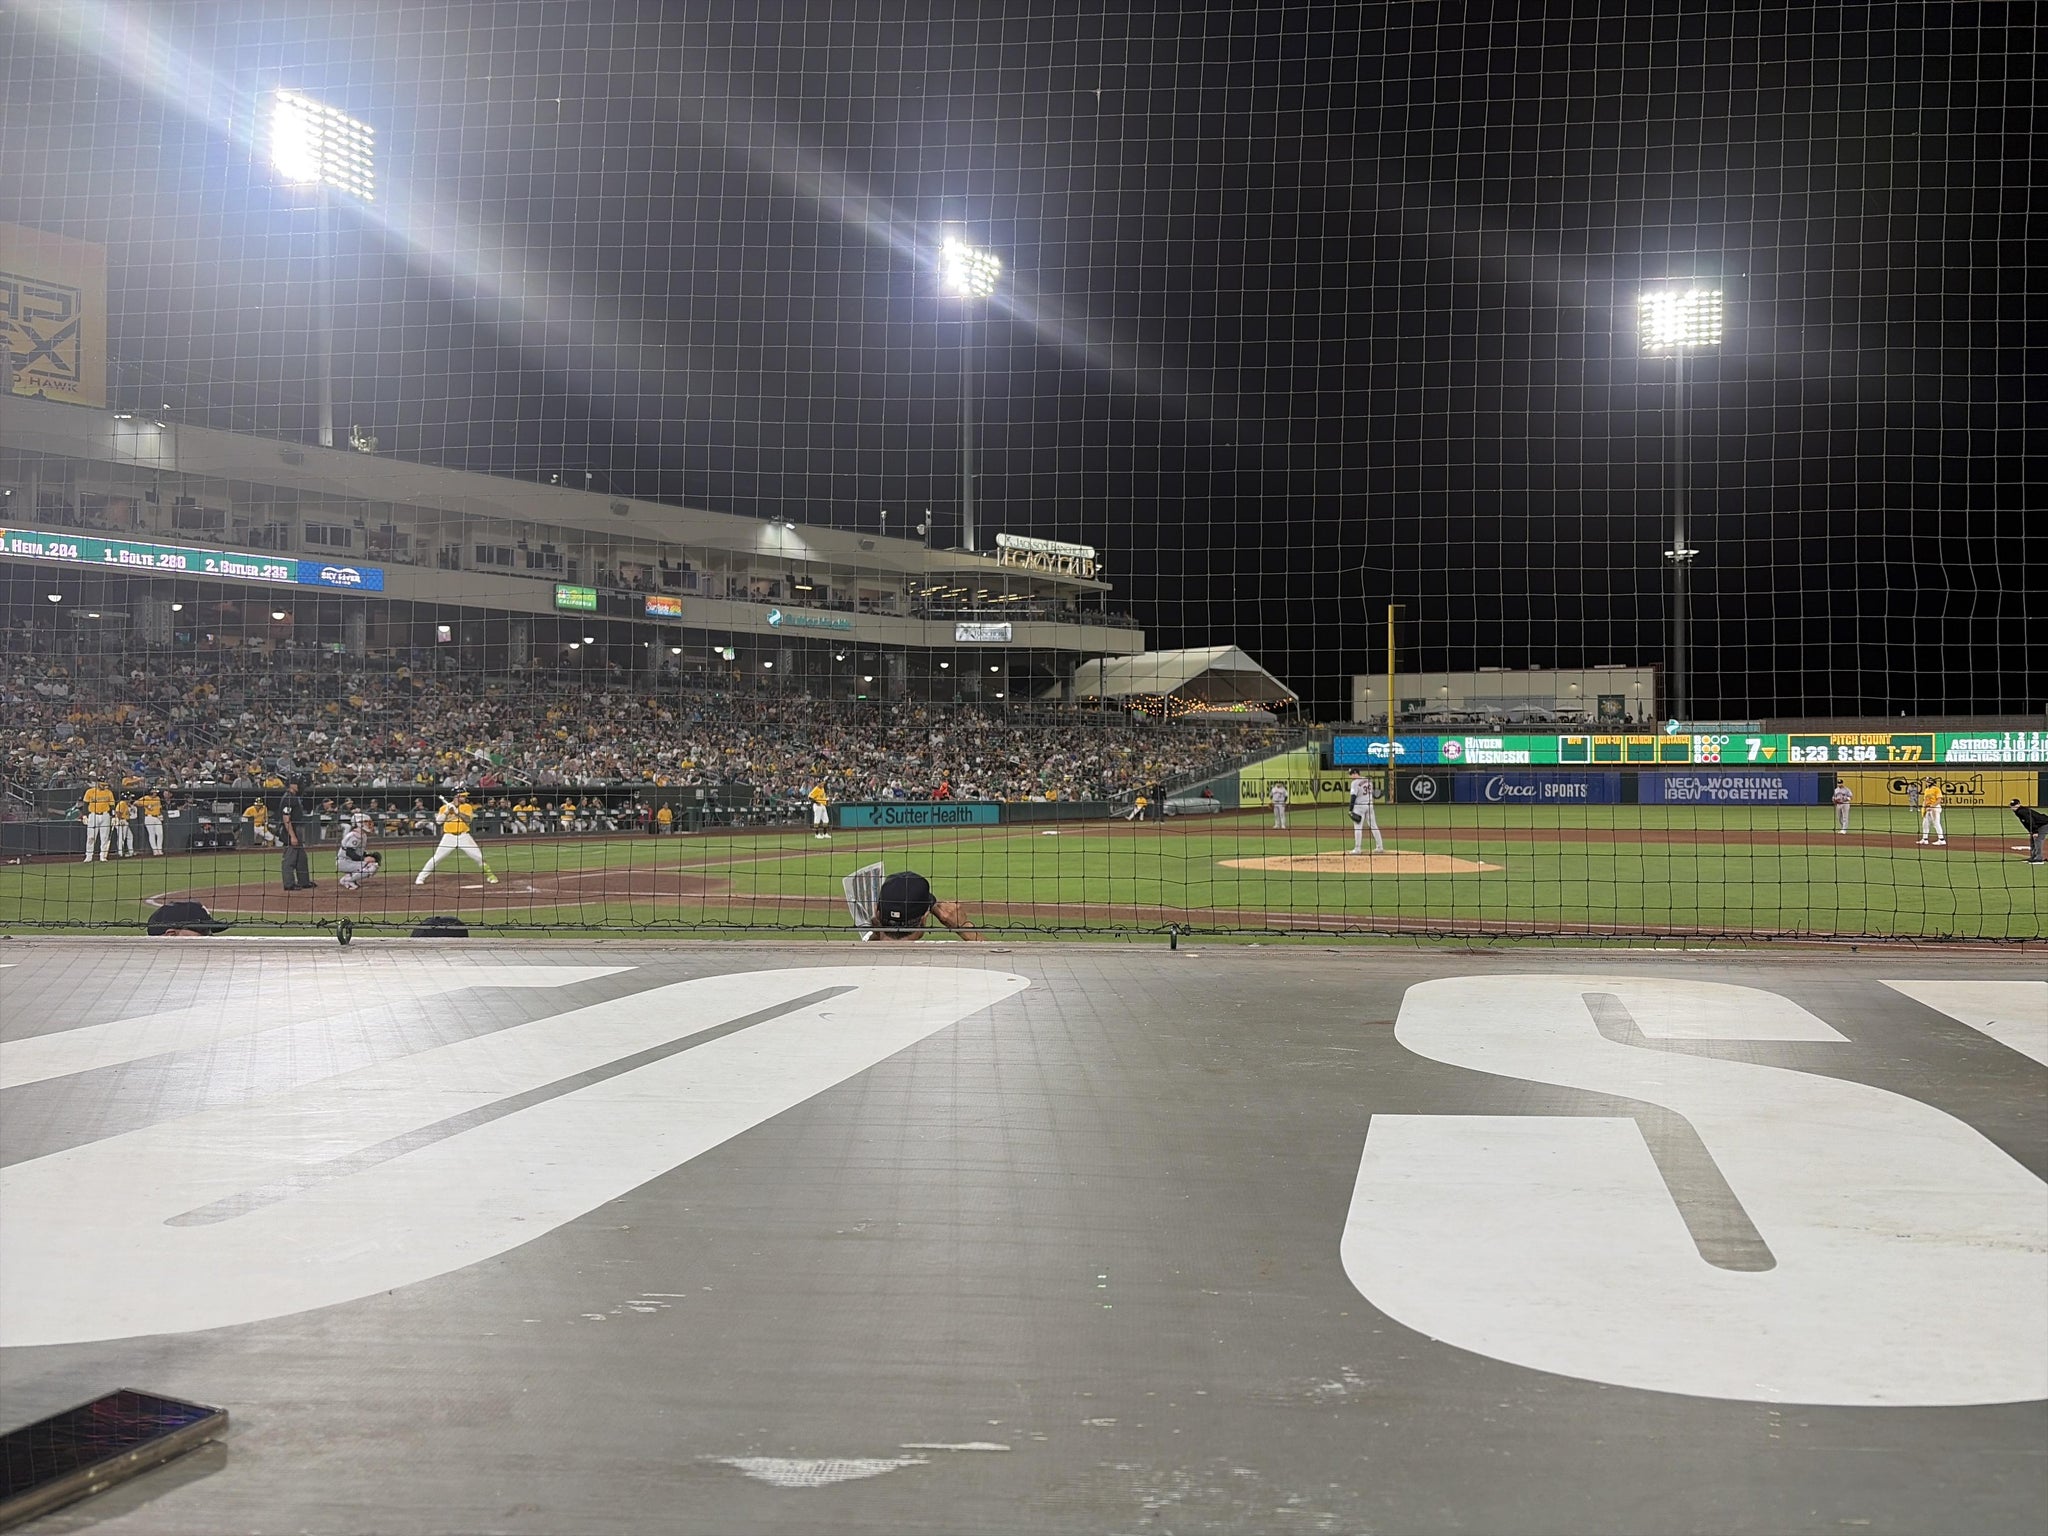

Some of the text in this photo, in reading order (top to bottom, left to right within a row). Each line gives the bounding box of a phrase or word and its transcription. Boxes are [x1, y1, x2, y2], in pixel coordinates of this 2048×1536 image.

[29, 376, 79, 393] HAWK
[1830, 735, 1892, 745] PITCH COUNT
[1951, 739, 1998, 750] ASTROS
[1745, 738, 1761, 761] 7
[1791, 745, 1828, 761] B:23
[1887, 745, 1923, 761] T:77
[1242, 781, 1257, 798] CALL
[1414, 781, 1431, 794] 42
[1485, 775, 1587, 801] Circa SPORTS
[1664, 778, 1700, 788] NECA
[1708, 778, 1783, 788] WORKING
[1664, 789, 1701, 800] IBEW
[1709, 789, 1788, 800] TOGETHER
[885, 807, 973, 824] Sutter Health
